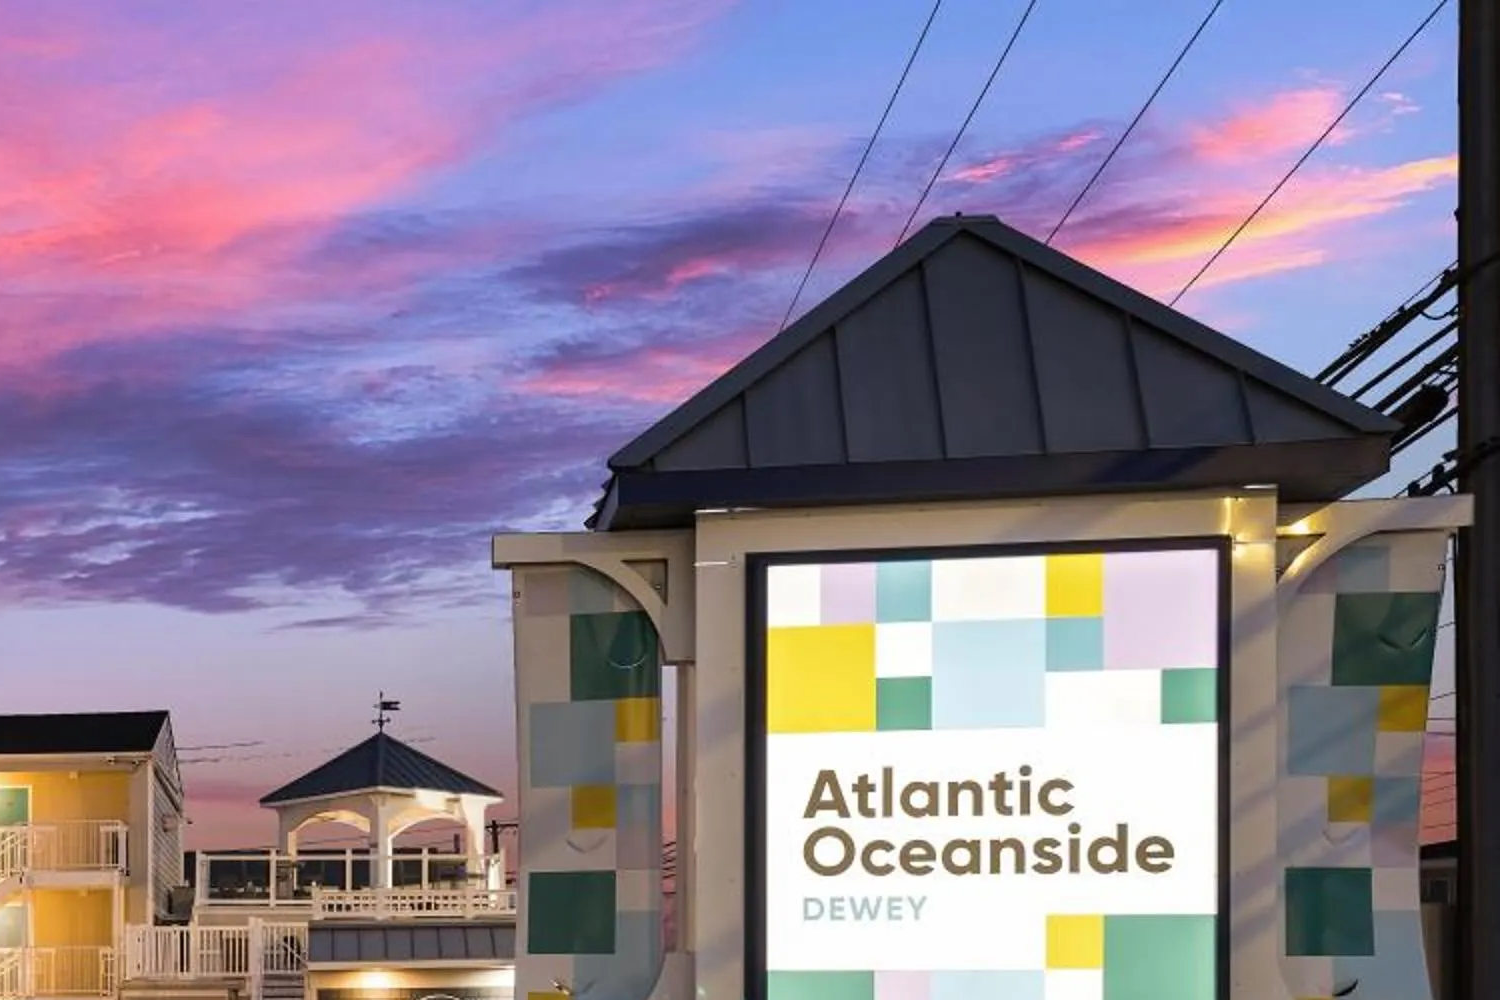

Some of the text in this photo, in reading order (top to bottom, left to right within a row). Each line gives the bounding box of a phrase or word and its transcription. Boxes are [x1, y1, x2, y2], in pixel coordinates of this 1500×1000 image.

[803, 764, 1075, 819] Atlantic
[803, 823, 1175, 877] Oceanside
[803, 895, 927, 921] DEWEY
